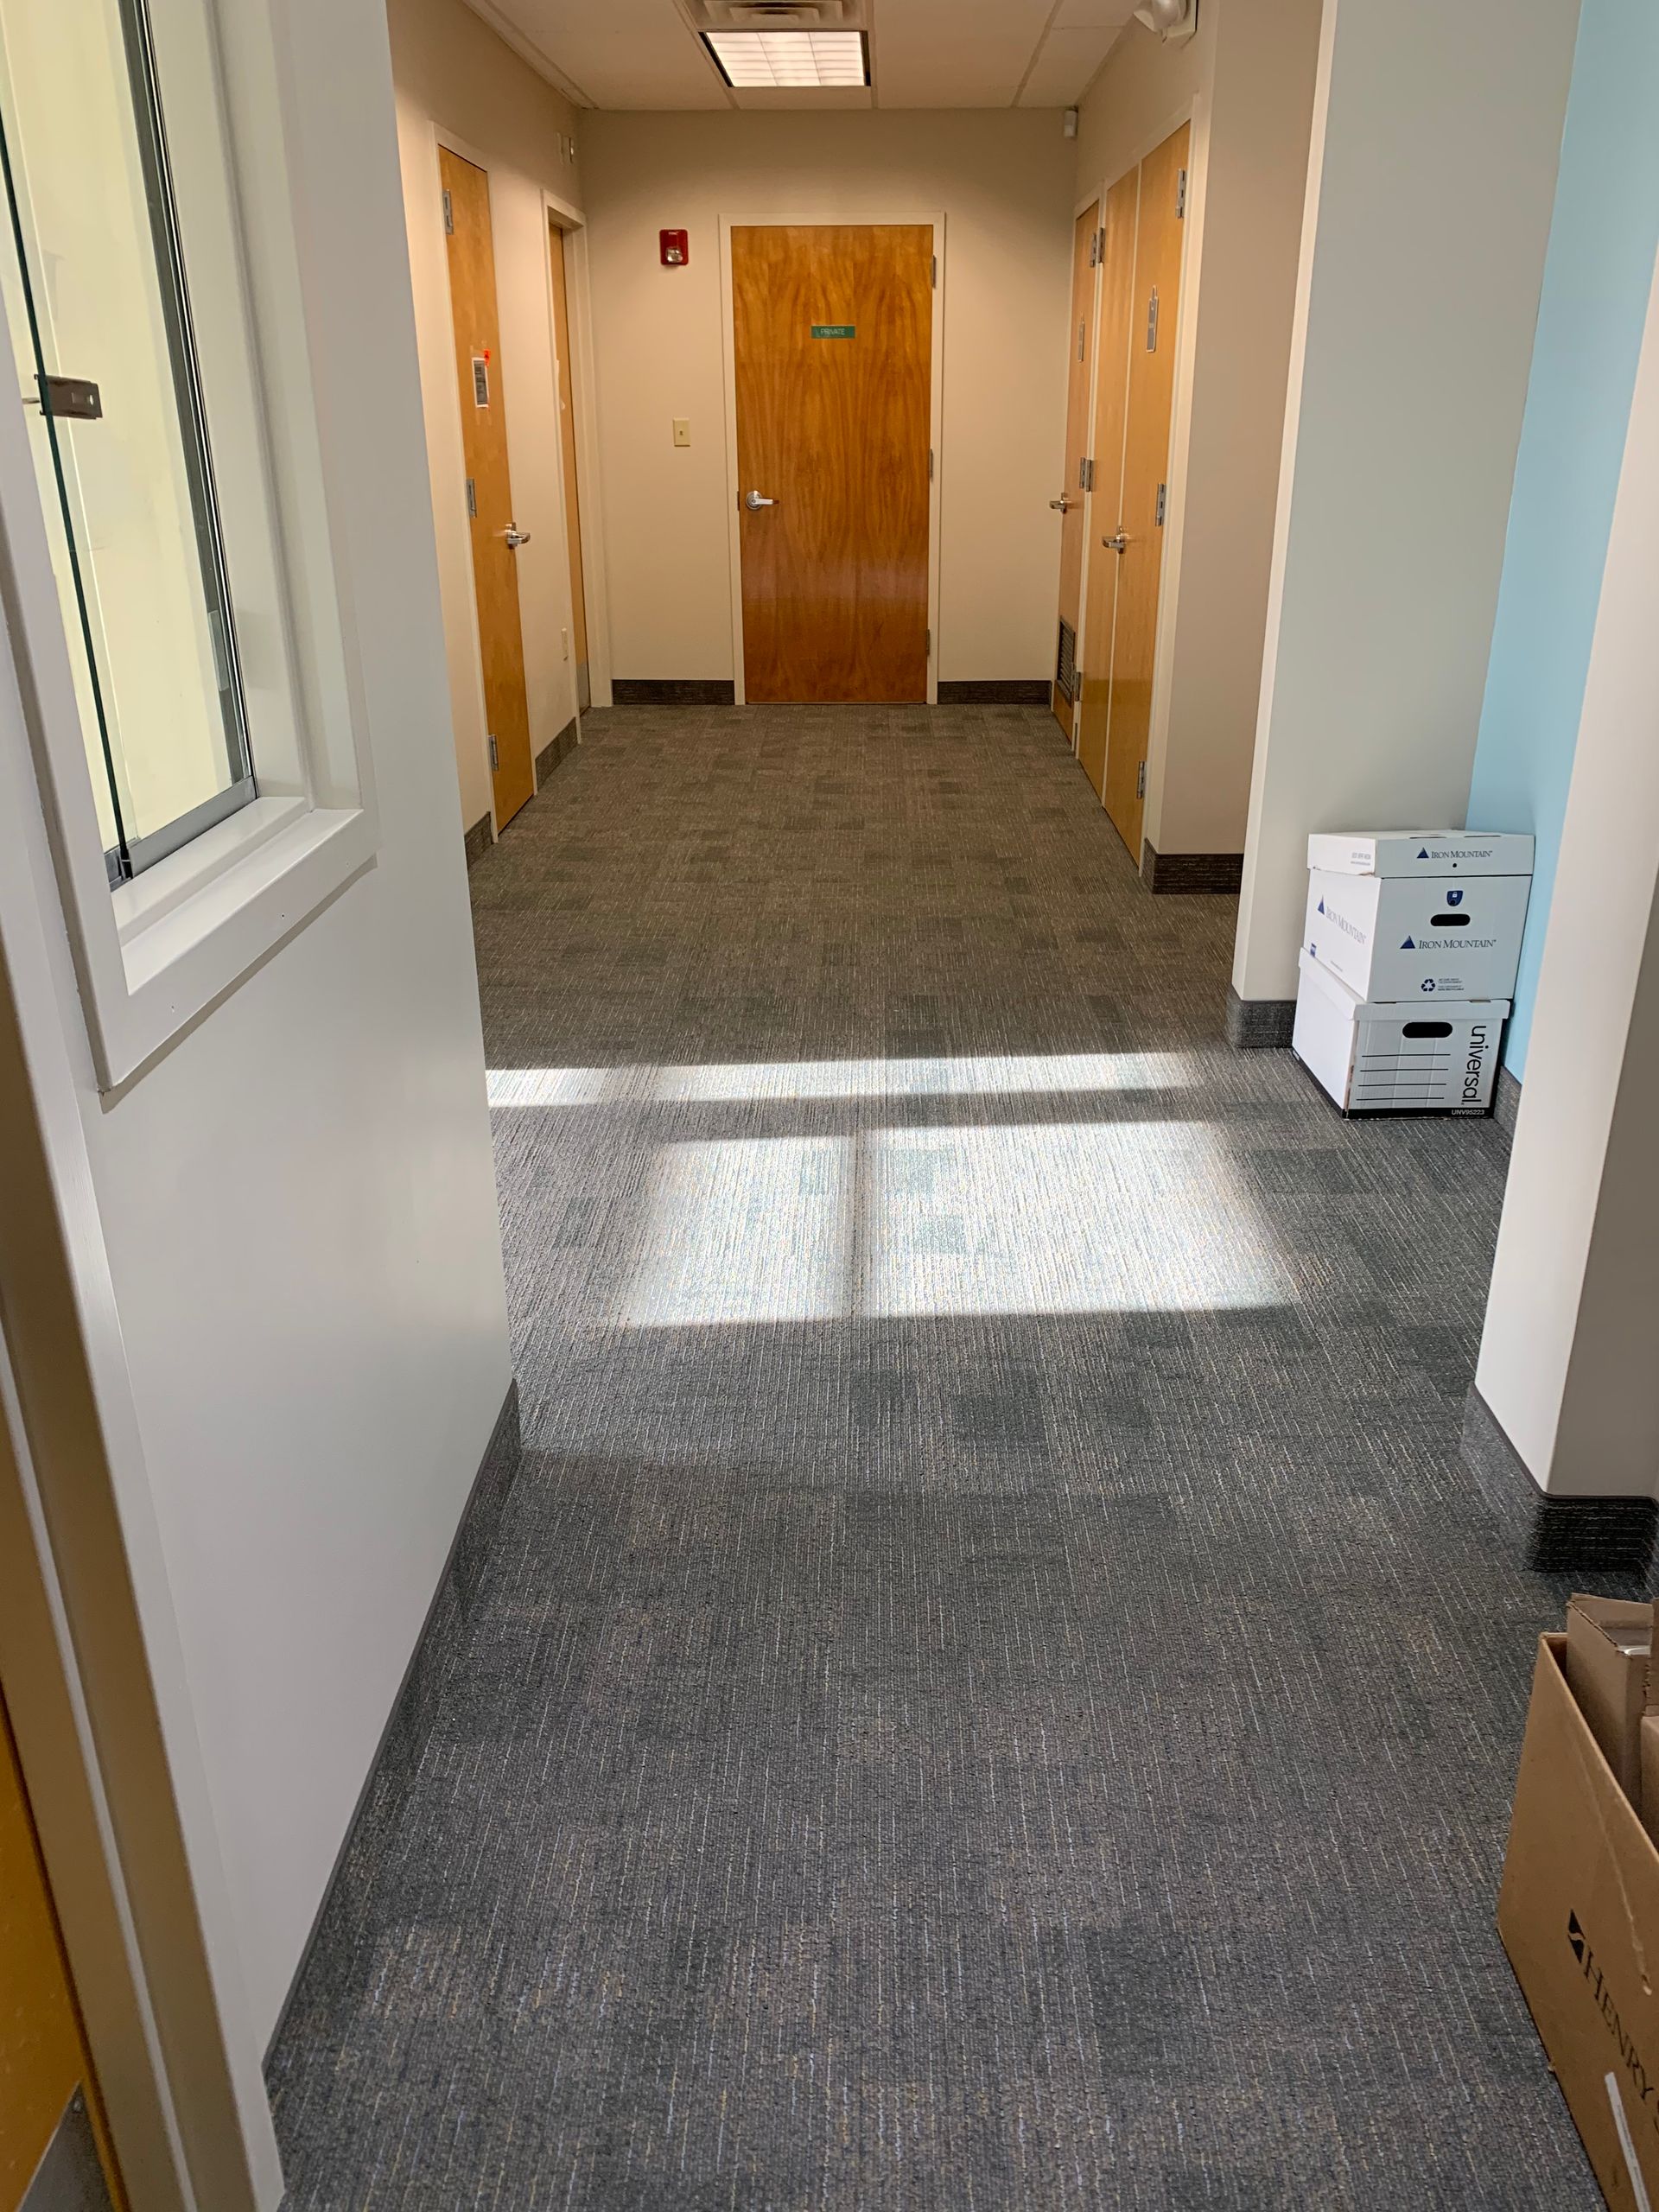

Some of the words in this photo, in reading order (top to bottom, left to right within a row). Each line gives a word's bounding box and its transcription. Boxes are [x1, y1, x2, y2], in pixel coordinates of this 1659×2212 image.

[1431, 850, 1450, 859] IRON
[1451, 850, 1491, 859] MOUNTAIN
[1419, 939, 1442, 949] IRON
[1443, 939, 1493, 949] MOUNTAIN
[1461, 1025, 1489, 1103] universal
